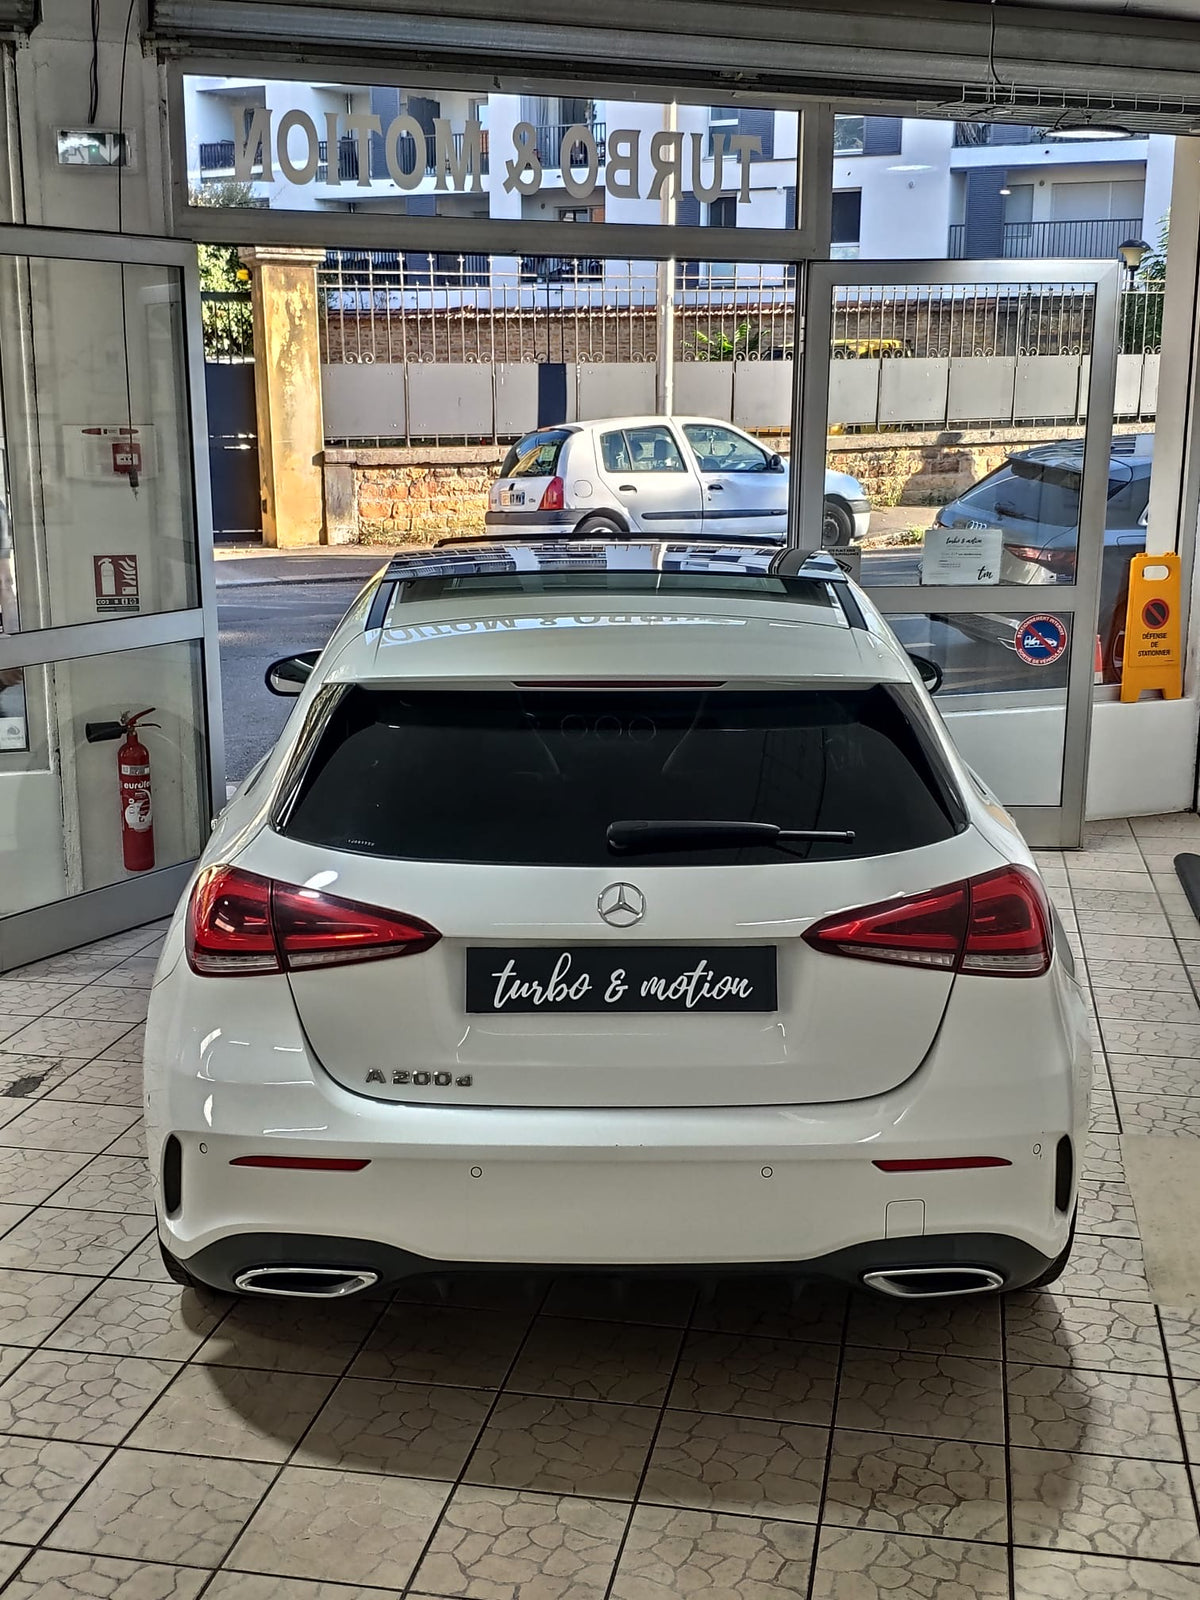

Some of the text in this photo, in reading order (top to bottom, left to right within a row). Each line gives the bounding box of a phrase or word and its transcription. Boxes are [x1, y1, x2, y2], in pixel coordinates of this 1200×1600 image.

[1138, 649, 1171, 657] STATIONNER
[491, 952, 753, 1008] turbo & motion
